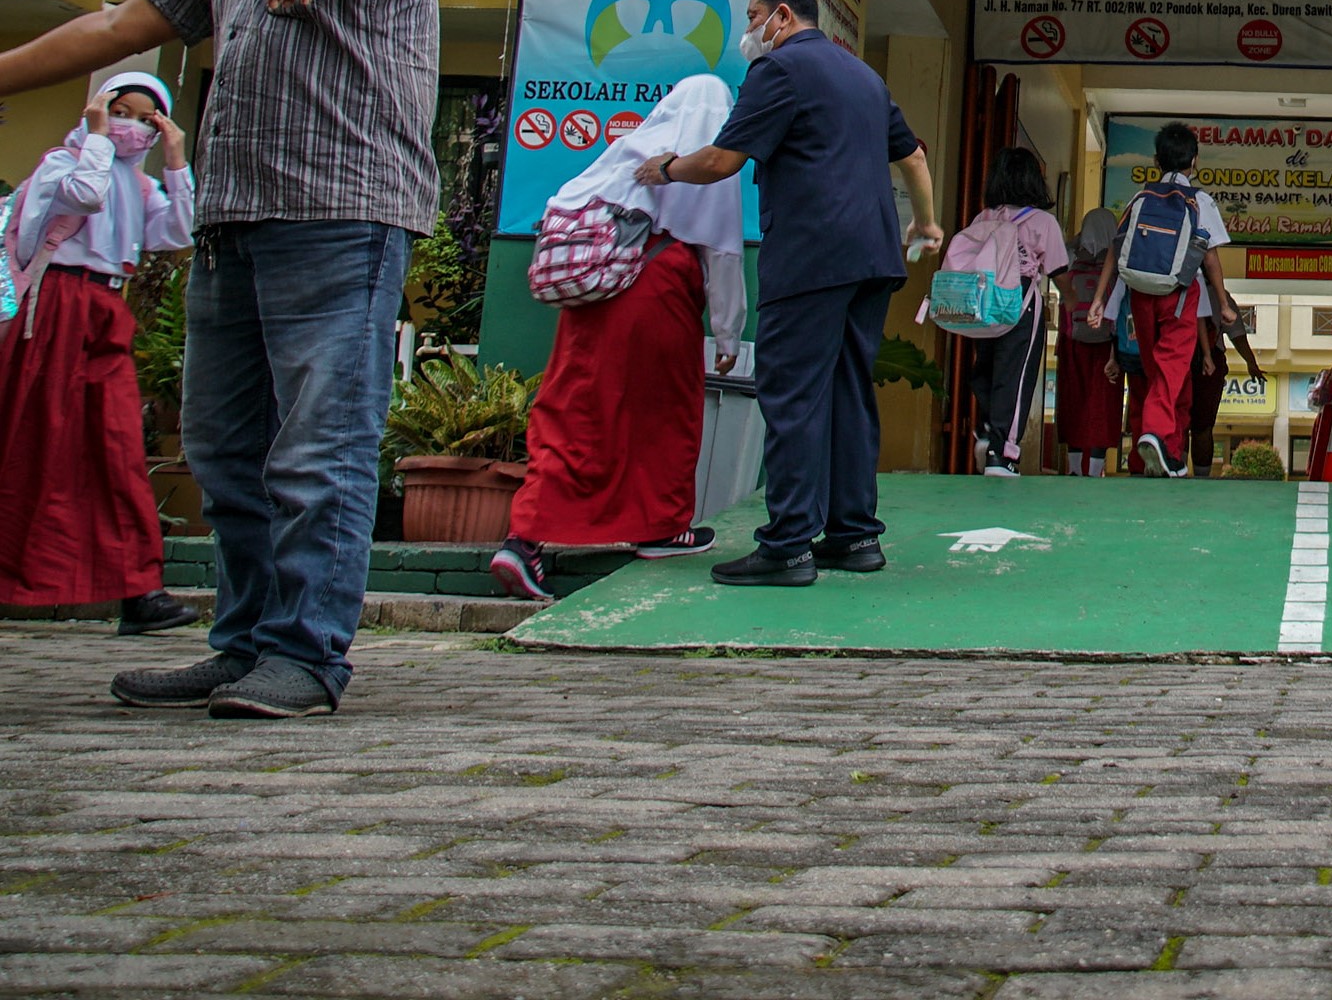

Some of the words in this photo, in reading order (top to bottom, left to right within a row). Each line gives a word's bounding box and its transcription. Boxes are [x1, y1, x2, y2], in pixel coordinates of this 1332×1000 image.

[984, 0, 997, 13] Jl.
[1000, 0, 1011, 13] H.
[1014, 0, 1049, 13] Naman
[1052, 0, 1068, 13] No.
[1071, 0, 1083, 13] 77
[1086, 1, 1102, 13] RT.
[1104, 1, 1147, 14] 002/RW.
[1150, 1, 1162, 14] 02
[1166, 1, 1204, 15] Pondok
[1206, 2, 1244, 18] Kelapa,
[1247, 3, 1269, 16] Kec.
[1272, 4, 1301, 17] Duren
[1241, 29, 1254, 37] NO
[1254, 29, 1279, 37] BULLY
[1247, 46, 1272, 55] ZONE
[524, 80, 626, 101] SEKOLAH
[609, 120, 621, 128] NO
[1285, 149, 1309, 167] di
[1209, 191, 1251, 203] UREN
[1254, 192, 1302, 205] SAWIT
[1226, 215, 1271, 234] kolah
[1277, 215, 1332, 235] Ramah
[1264, 254, 1295, 272] Bersama
[1296, 255, 1318, 272] Lawan
[1223, 378, 1265, 395] AGI
[948, 543, 1005, 553] IN
